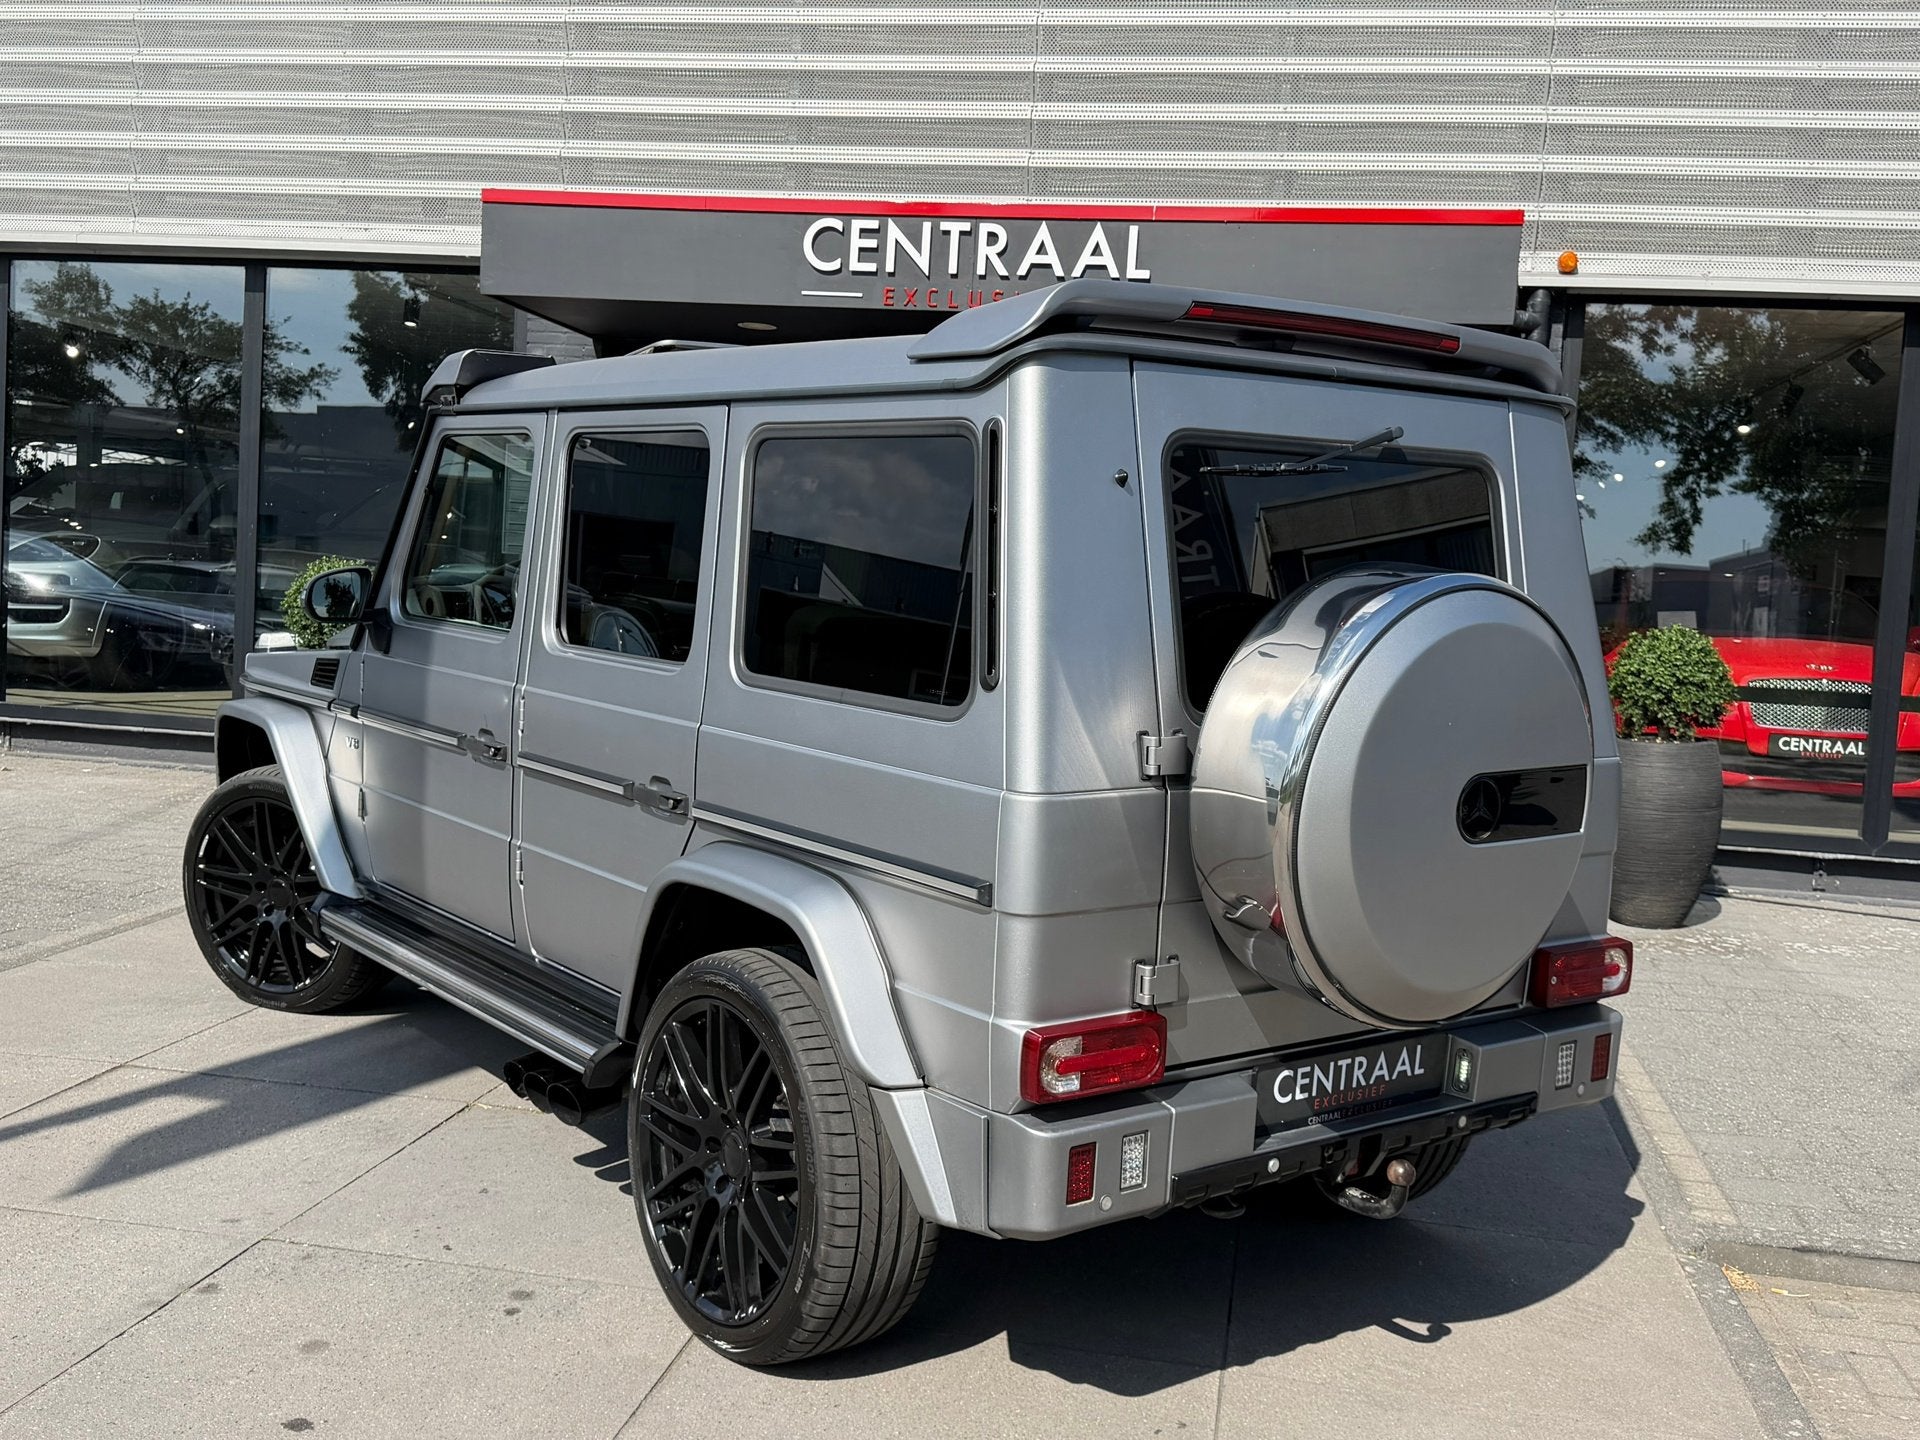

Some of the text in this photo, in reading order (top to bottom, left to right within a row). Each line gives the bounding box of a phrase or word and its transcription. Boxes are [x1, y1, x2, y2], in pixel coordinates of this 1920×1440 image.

[802, 217, 1151, 280] CENTRAAL
[882, 286, 1020, 308] EXCLUS
[345, 736, 360, 750] V8
[1778, 736, 1865, 755] CENTRAAL
[1273, 1044, 1425, 1103] CENTRAAL
[1314, 1083, 1387, 1110] EXCLUSIEF
[1307, 1110, 1342, 1126] CENTRAAL
